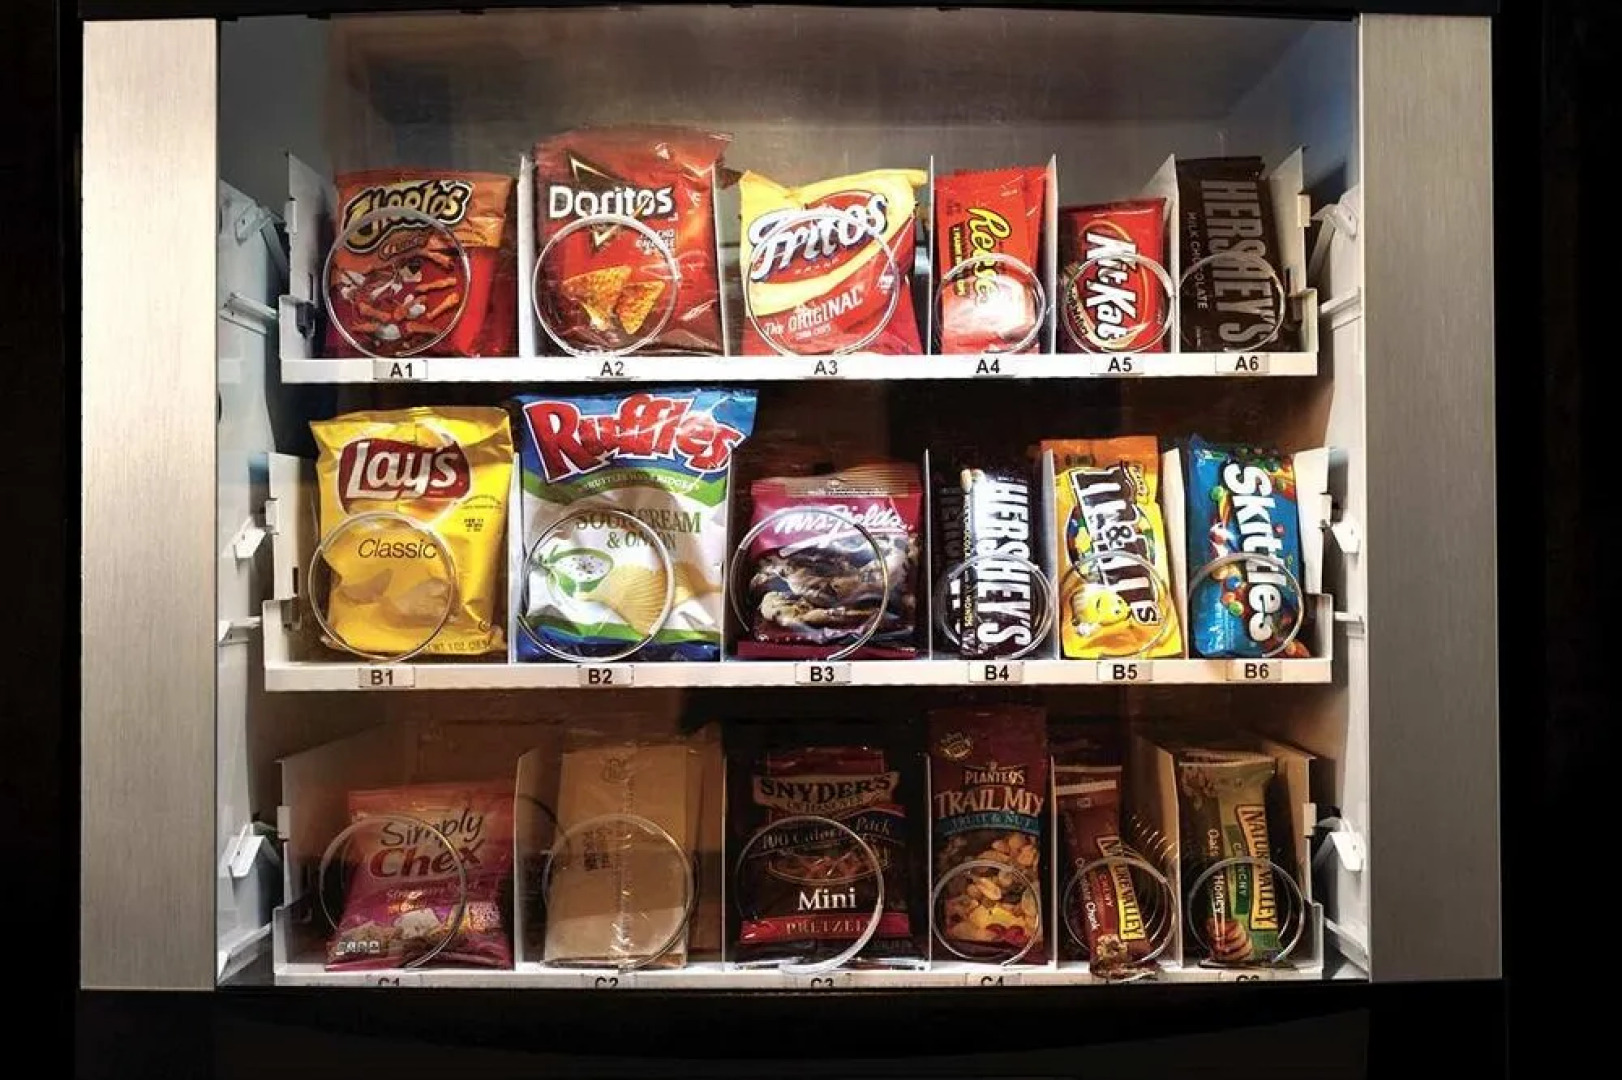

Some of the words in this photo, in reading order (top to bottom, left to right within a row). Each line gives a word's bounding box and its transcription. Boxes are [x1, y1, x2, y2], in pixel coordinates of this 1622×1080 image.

[549, 185, 674, 219] Doritos
[749, 193, 888, 280] Fritos
[1201, 179, 1279, 344] HERSHEY'S
[1190, 242, 1208, 309] CHOOLATE
[787, 284, 865, 332] ORIGINAL
[389, 362, 414, 377] A1
[600, 361, 625, 377] A2
[814, 360, 838, 376] A3
[975, 359, 1000, 374] A4
[1107, 357, 1133, 372] A5
[1235, 356, 1259, 371] A6
[524, 394, 747, 483] Ruffles
[346, 440, 458, 500] Lay's
[637, 508, 701, 534] CREAM
[357, 538, 438, 559] Classic
[606, 531, 621, 549] &
[625, 531, 677, 551] ONON
[1222, 461, 1287, 642] Skittles
[975, 483, 1032, 646] HERSHEY'S
[370, 670, 394, 685] B1
[588, 669, 613, 684] B2
[810, 667, 834, 682] B3
[984, 665, 1009, 681] B4
[1112, 665, 1138, 681] B5
[1244, 664, 1269, 679] B6
[760, 773, 891, 804] SNYDER'S
[934, 788, 1001, 818] TRAIL
[1002, 785, 1044, 818] MIX
[380, 807, 484, 847] Simply
[368, 838, 485, 879] Chex
[1240, 809, 1269, 867] NATUR
[1255, 869, 1277, 926] VALLEY
[797, 887, 857, 911] Mini
